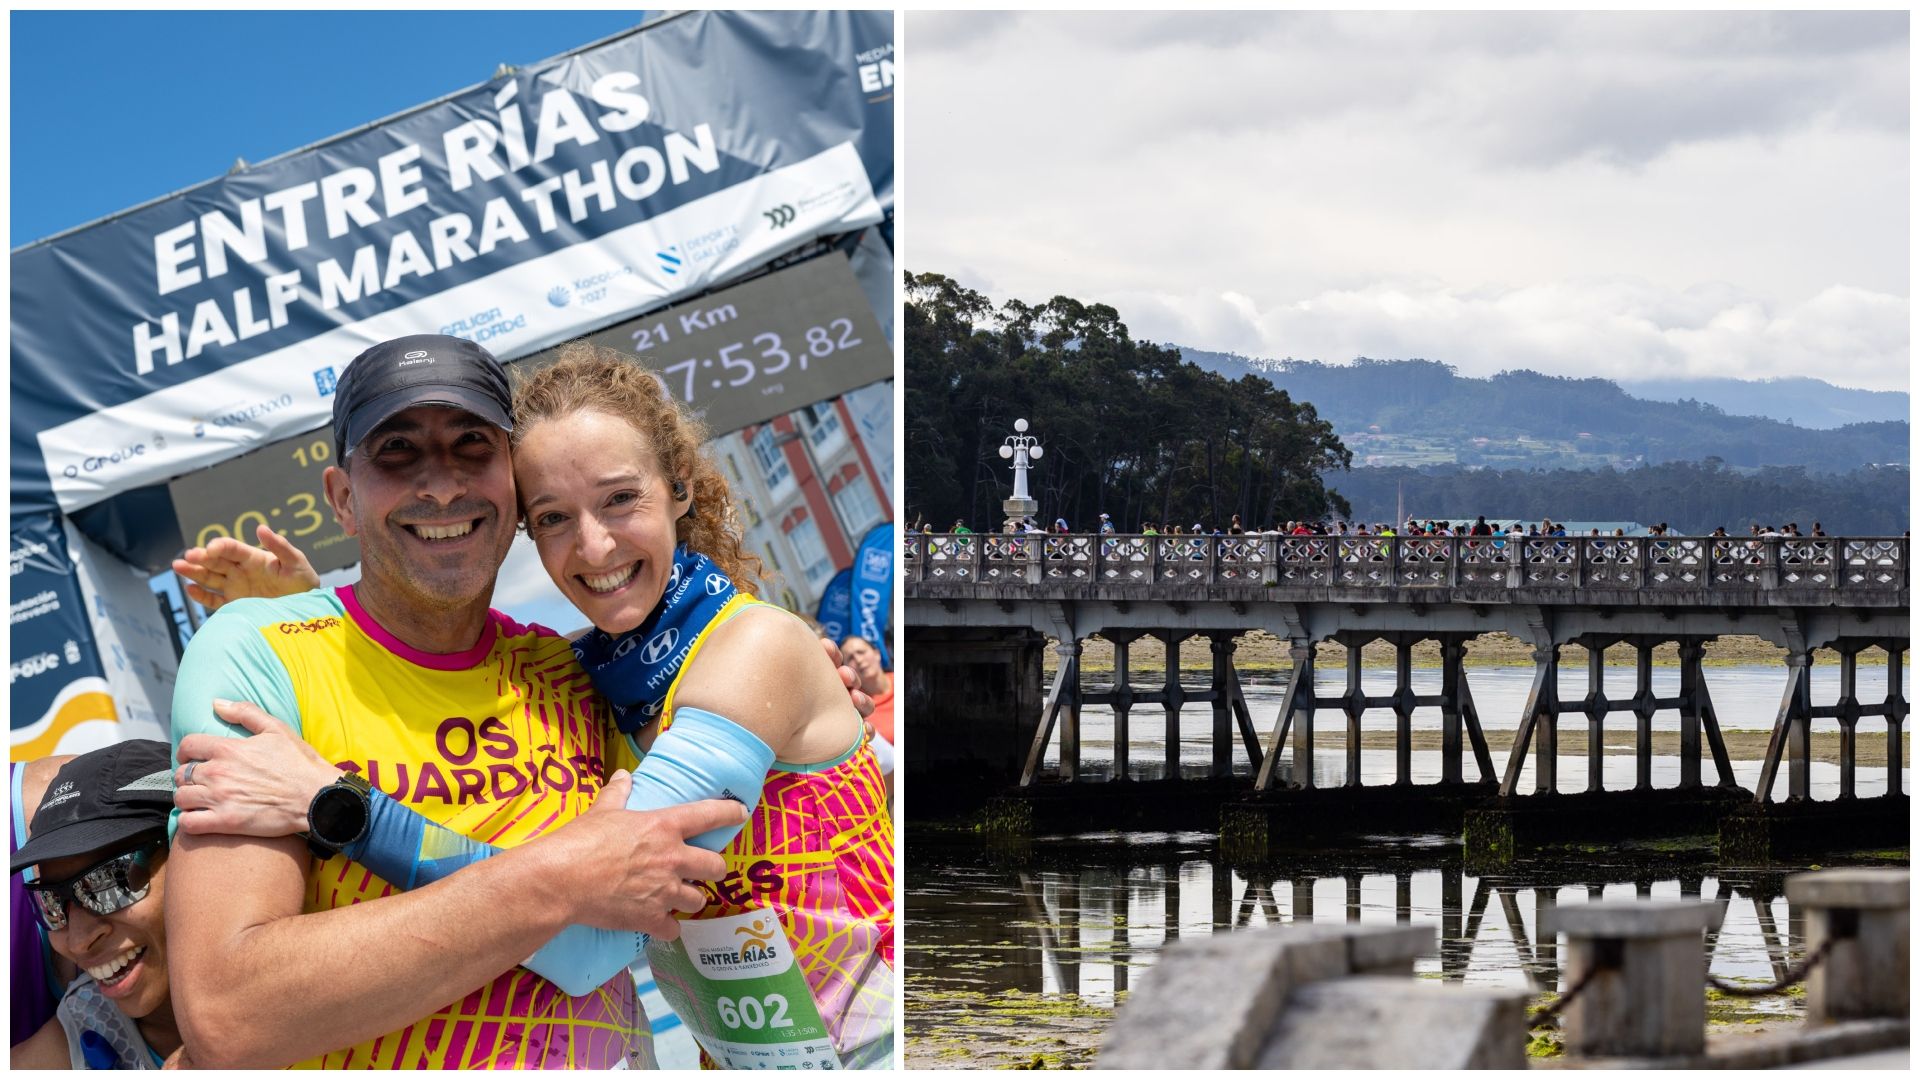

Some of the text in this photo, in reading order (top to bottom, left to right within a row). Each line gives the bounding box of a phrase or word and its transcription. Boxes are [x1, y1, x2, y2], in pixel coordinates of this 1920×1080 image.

[153, 70, 650, 296] ENTRE RÍAS
[132, 122, 721, 376] HALF MARATHON
[631, 303, 738, 351] 21 Km
[211, 393, 293, 428] SANXENXO
[292, 440, 330, 468] 10
[435, 716, 519, 766] OS
[699, 946, 777, 966] ENTRE RÍAS
[716, 993, 794, 1030] 602
